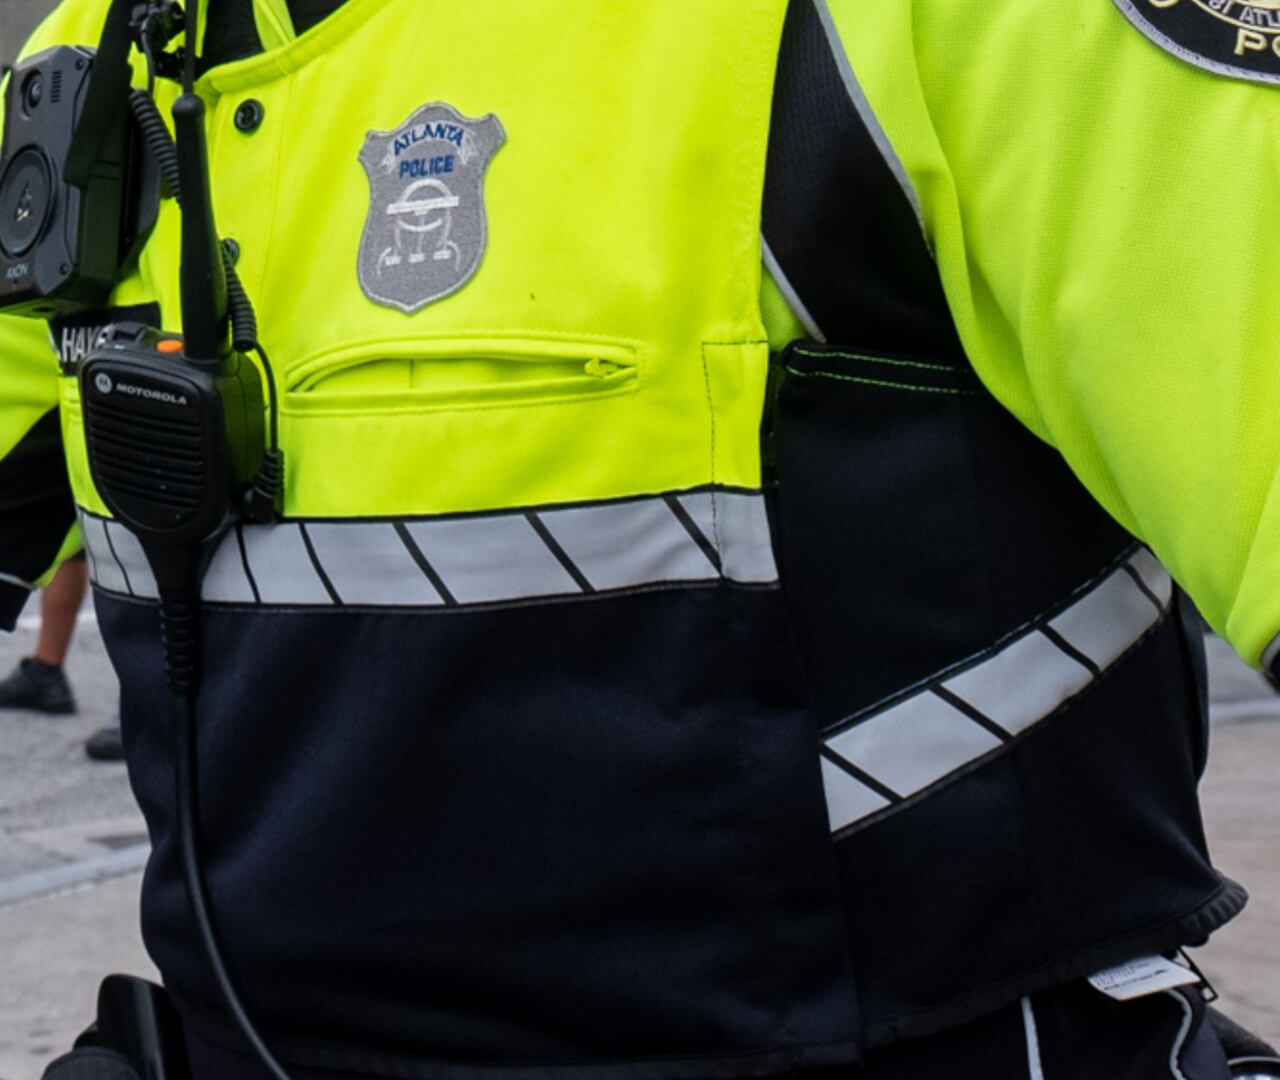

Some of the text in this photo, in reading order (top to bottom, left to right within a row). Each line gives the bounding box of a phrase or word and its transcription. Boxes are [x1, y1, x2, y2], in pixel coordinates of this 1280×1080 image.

[393, 123, 465, 156] ATLANTA
[399, 153, 455, 179] POLICE
[6, 262, 29, 279] AXON
[61, 325, 101, 363] HAY
[115, 382, 188, 406] MOTOROLA
